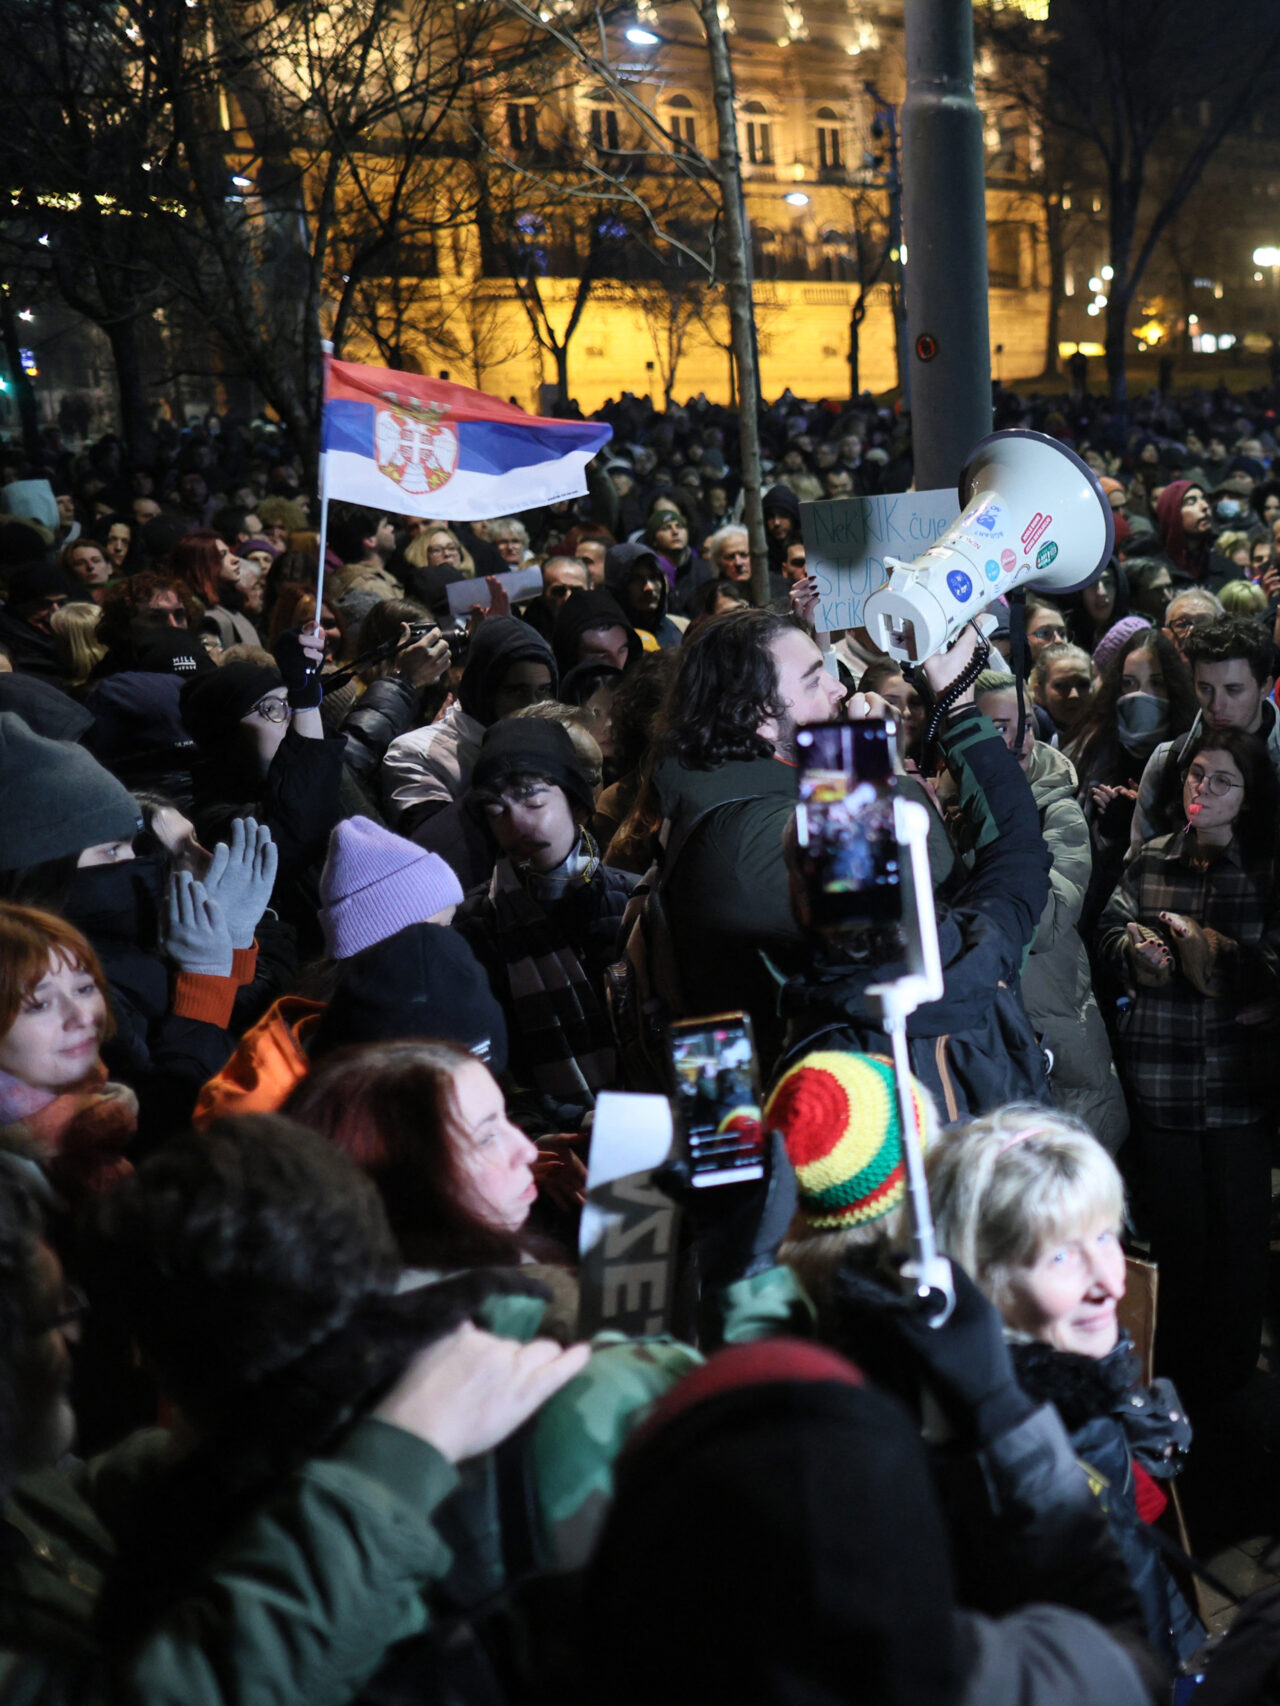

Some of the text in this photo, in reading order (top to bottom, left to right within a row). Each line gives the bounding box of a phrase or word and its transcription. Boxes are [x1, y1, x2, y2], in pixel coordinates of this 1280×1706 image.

[813, 497, 947, 545] Nek RIK čuje
[822, 597, 864, 629] krik
